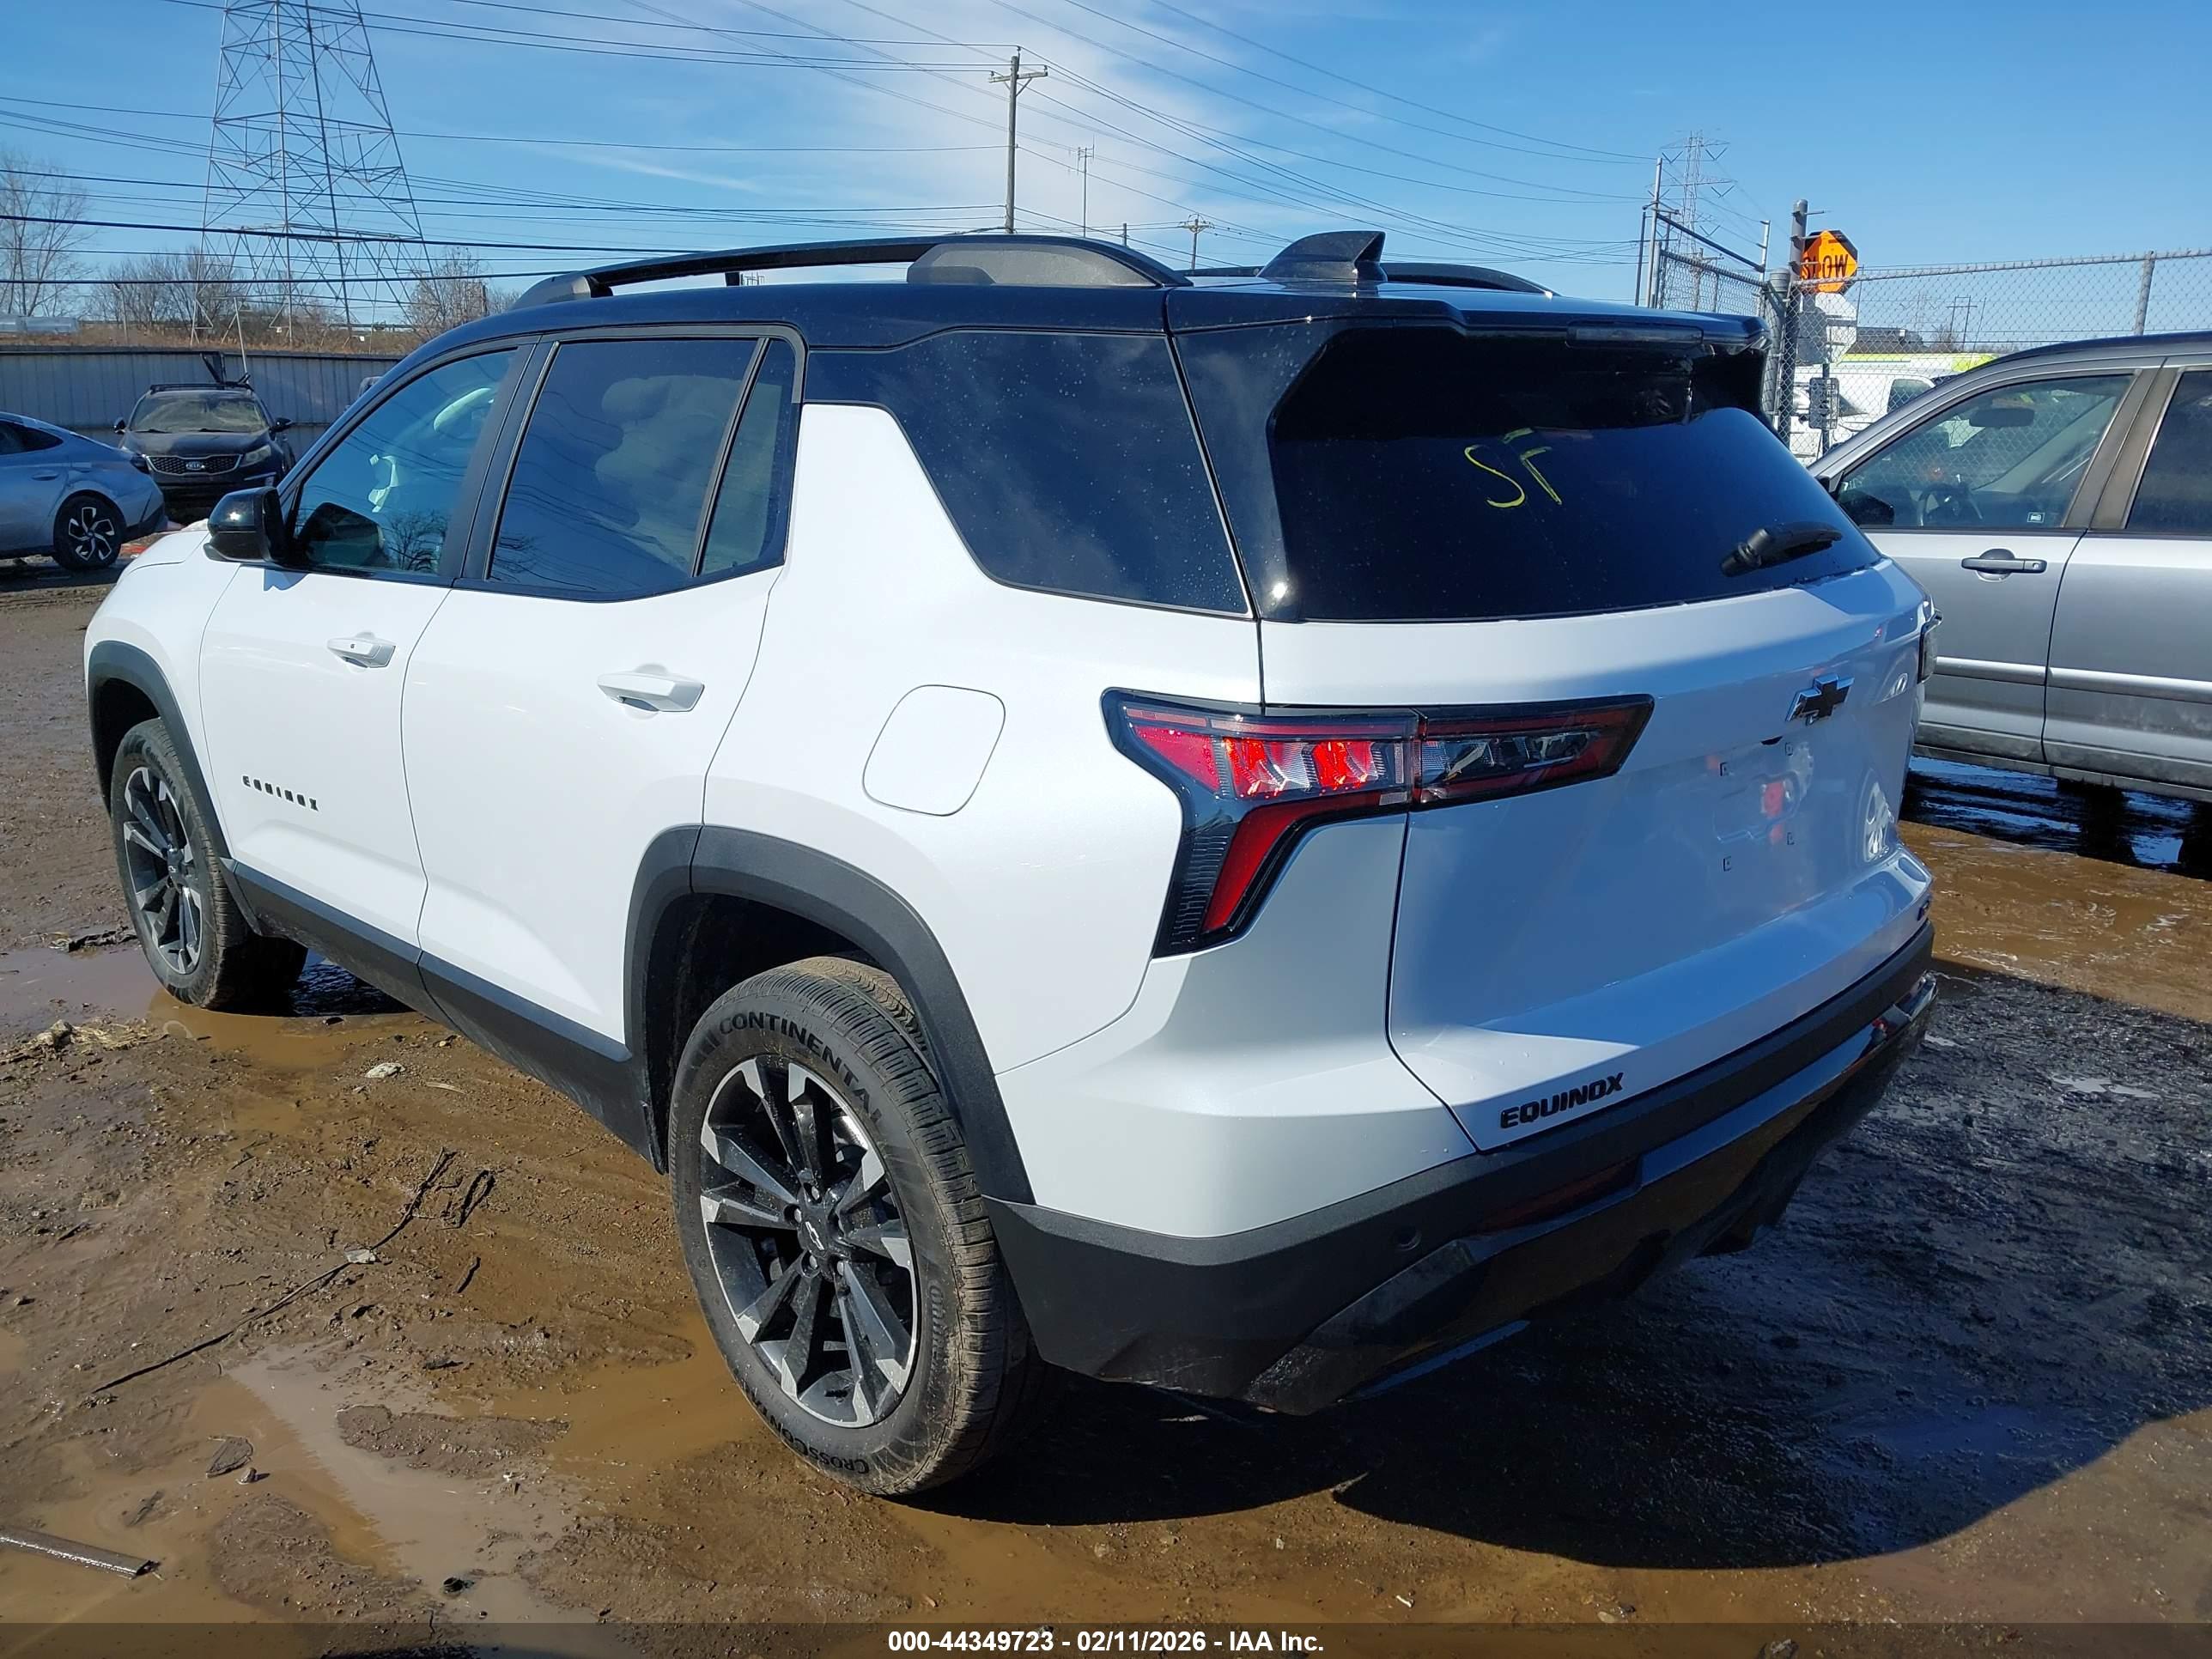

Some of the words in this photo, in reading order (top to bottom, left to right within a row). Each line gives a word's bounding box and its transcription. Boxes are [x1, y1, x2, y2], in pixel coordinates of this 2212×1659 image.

[1801, 253, 1849, 279] SLOW
[242, 775, 319, 811] EQUINOX
[719, 1012, 884, 1123] CONTINENTAL
[1501, 1073, 1624, 1128] EQUINOX
